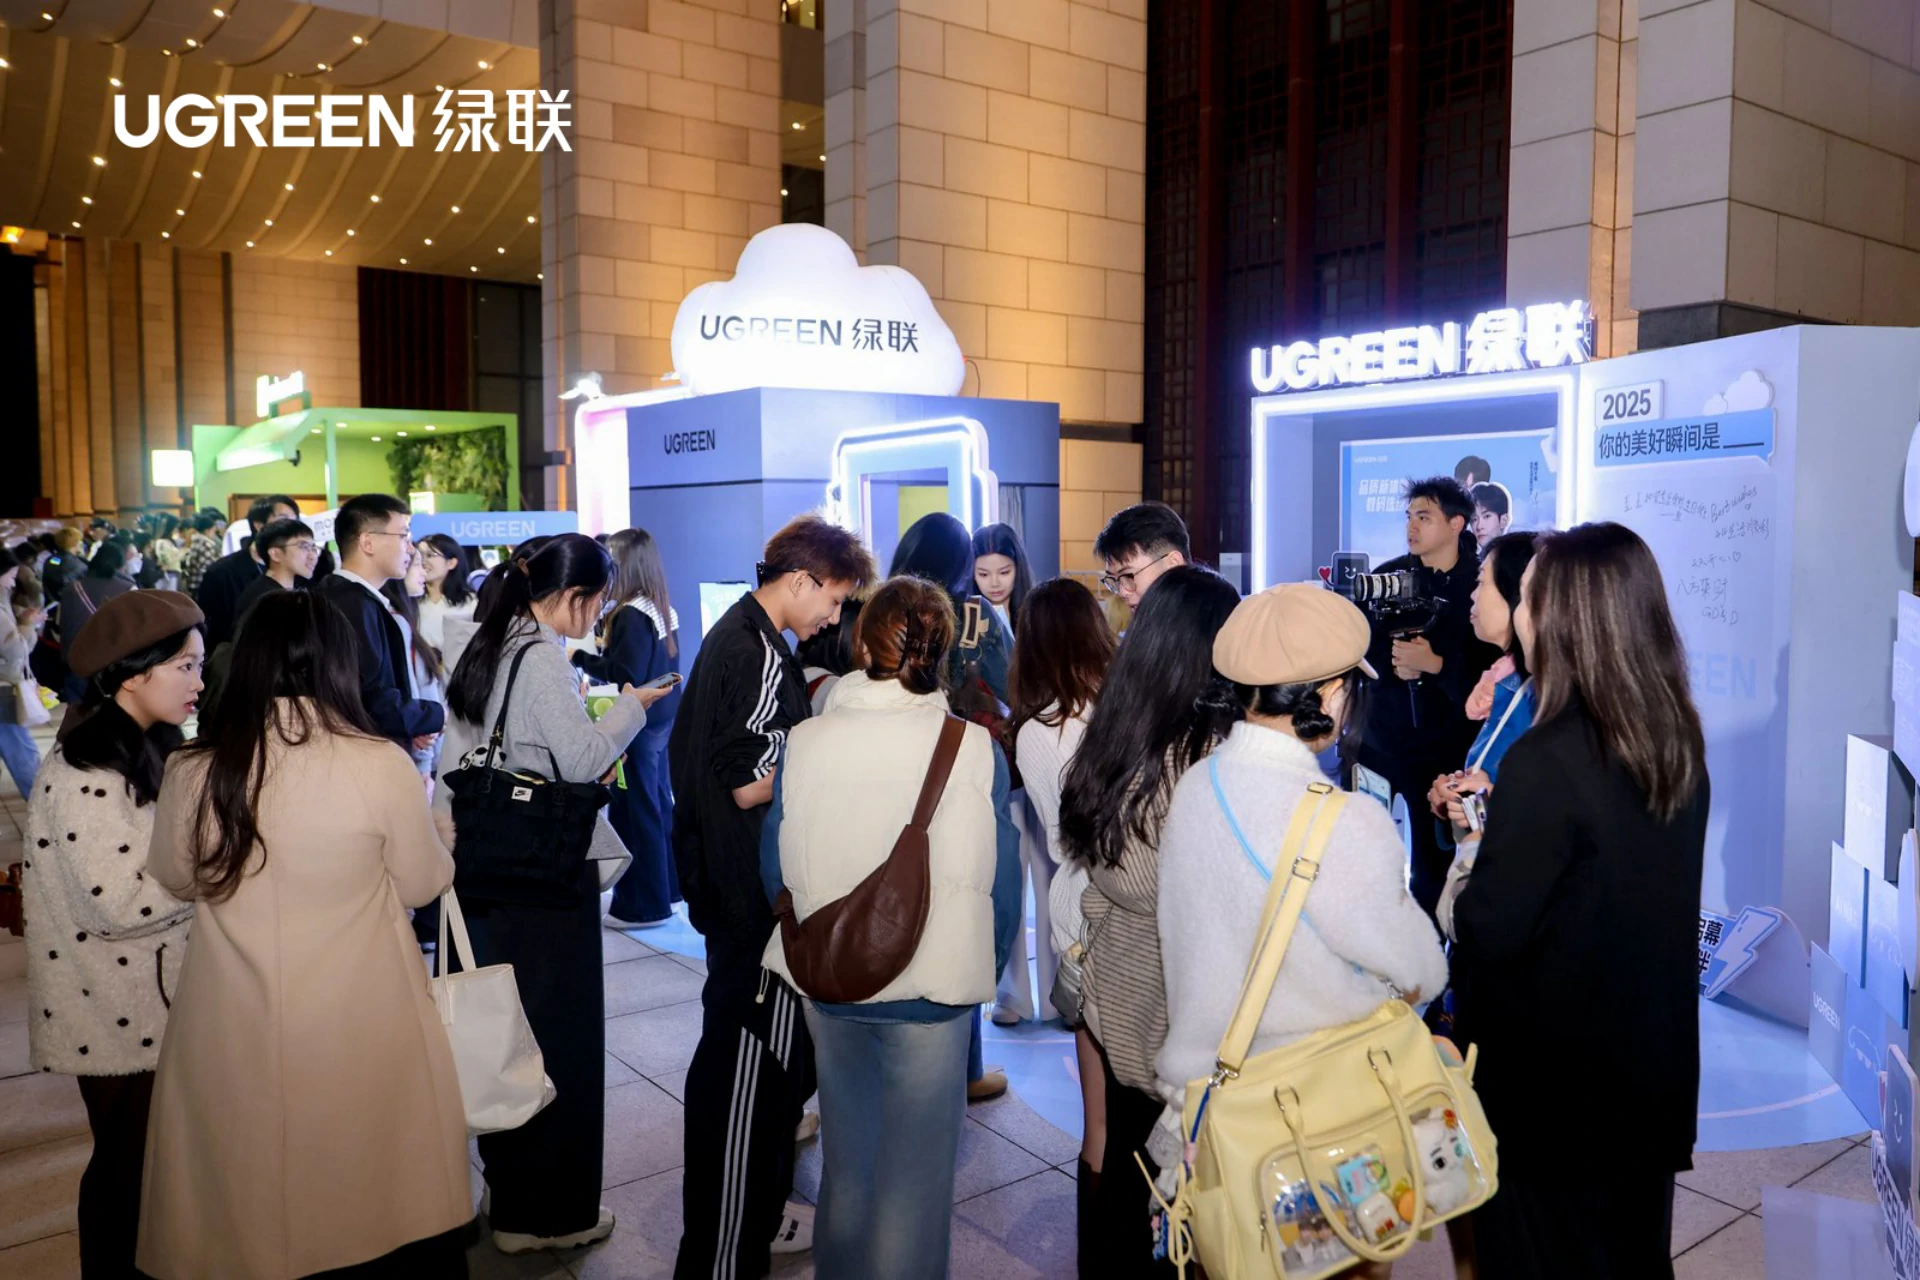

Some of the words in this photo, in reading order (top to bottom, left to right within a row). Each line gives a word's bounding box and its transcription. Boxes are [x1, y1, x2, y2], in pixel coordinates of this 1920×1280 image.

[700, 315, 842, 346] UGREEN
[852, 318, 919, 353] 绿联
[1251, 321, 1461, 393] UGREEN
[1466, 299, 1593, 375] 绿联
[1603, 389, 1651, 420] 2025
[664, 429, 715, 455] UGREEN
[451, 519, 536, 538] UGREEN
[1812, 990, 1841, 1033] UGREEN
[1871, 1143, 1905, 1251] UGREEN
